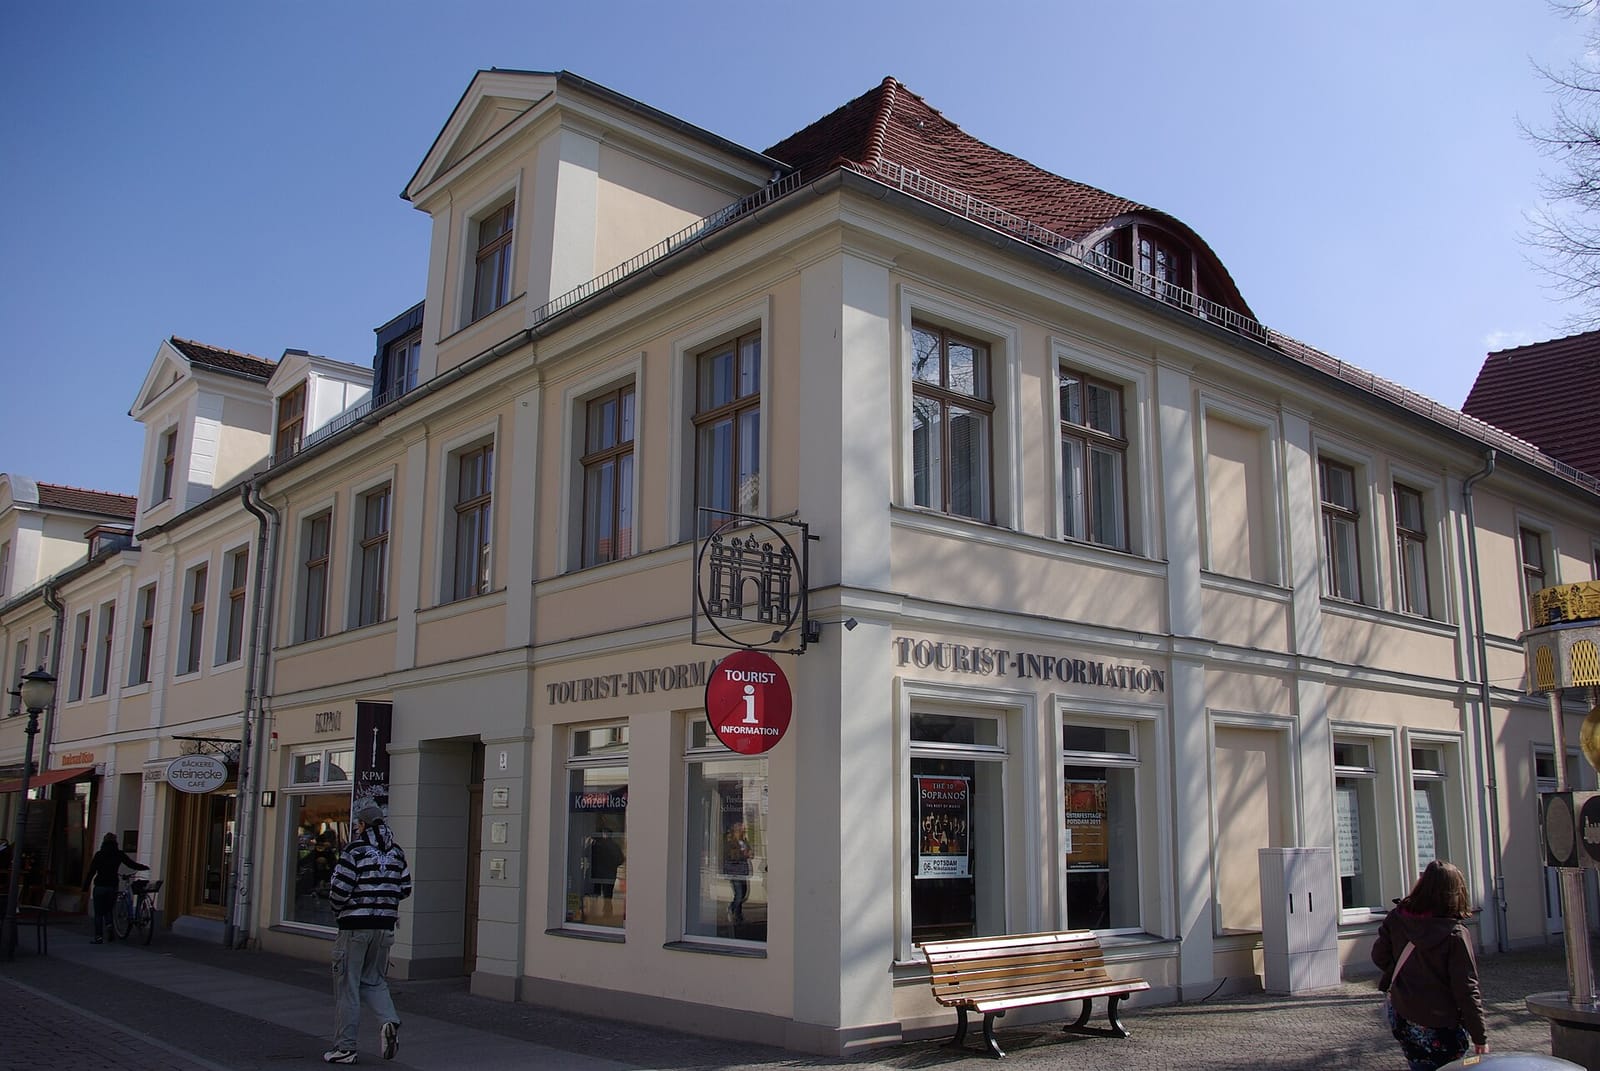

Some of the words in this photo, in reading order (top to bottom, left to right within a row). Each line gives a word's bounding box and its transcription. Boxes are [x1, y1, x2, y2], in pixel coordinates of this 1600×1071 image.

[894, 637, 1165, 693] TOURIST-INFORMATION
[725, 669, 776, 684] TOURIST
[721, 725, 779, 736] INFORMATION
[181, 759, 215, 768] BÄCKEREI
[171, 769, 223, 780] steinecke
[361, 770, 385, 781] KPM
[933, 859, 958, 867] POTSDAM
